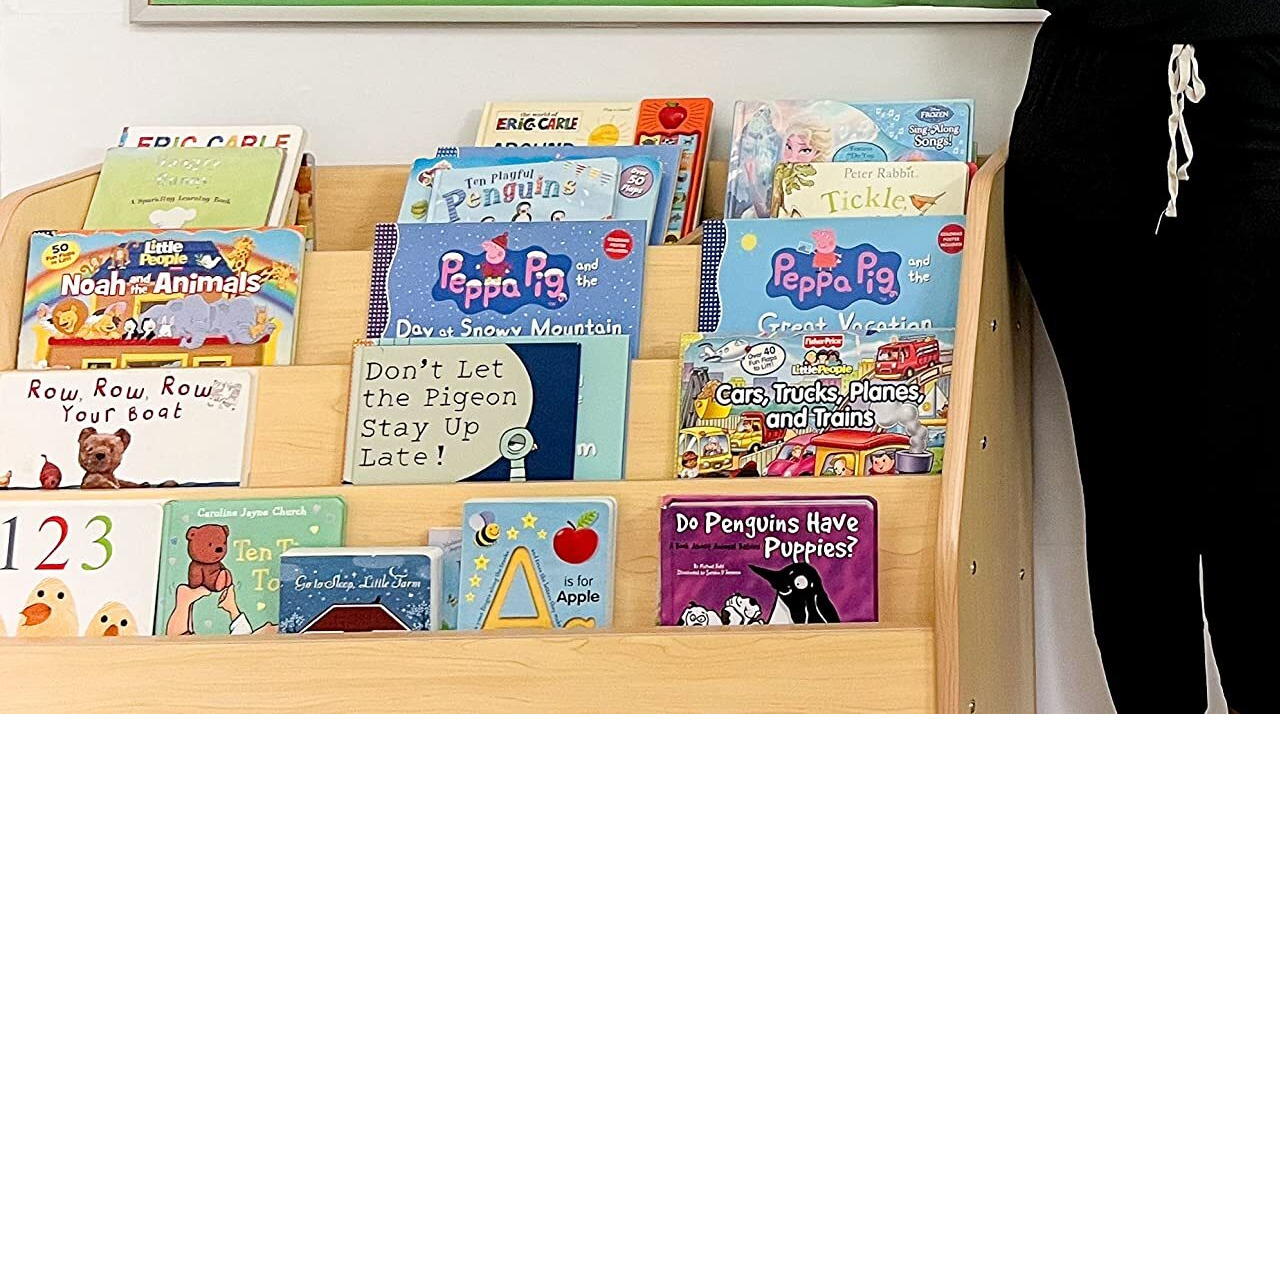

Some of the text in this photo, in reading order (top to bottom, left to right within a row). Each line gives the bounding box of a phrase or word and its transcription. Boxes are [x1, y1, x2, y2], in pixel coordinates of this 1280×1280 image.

[496, 117, 579, 131] ERIC CARLE
[920, 111, 949, 119] FROZEN
[914, 134, 953, 150] Songs!
[464, 168, 535, 190] Ten Playful
[627, 175, 646, 186] 50
[844, 166, 914, 179] Peter Rabbit
[442, 175, 577, 223] Penguins
[820, 187, 908, 215] Tickle,
[52, 243, 69, 254] 50
[145, 239, 184, 254] Little
[139, 252, 188, 267] People
[576, 258, 599, 271] and
[908, 254, 931, 268] and
[61, 273, 262, 297] Noah and Animals
[441, 250, 569, 309] Peppa Pig
[576, 273, 598, 287] the
[774, 251, 898, 302] Peppa Pig
[908, 270, 930, 283] the
[130, 283, 148, 295] the
[396, 318, 622, 337] Day at Snowy Mountain
[804, 337, 842, 346] Fisher-Price
[748, 346, 776, 360] Over 40
[748, 358, 760, 366] Fun
[365, 358, 504, 381] Don't Let
[161, 375, 213, 398] Row
[716, 381, 926, 406] Cars, Trucks, Planes,
[363, 386, 517, 412] the Pigeon
[62, 401, 183, 424] Your Boat
[766, 407, 875, 428] and Trains
[360, 417, 480, 442] Stay Up
[358, 445, 445, 467] Late!
[197, 506, 307, 518] Caroline Jayne Church
[676, 511, 859, 539] Do Penguins Have
[35, 515, 69, 570] 2
[81, 515, 113, 571] 3
[233, 539, 273, 563] Ten
[764, 535, 859, 564] Puppies?
[295, 574, 313, 591] Go
[313, 579, 325, 589] to
[325, 574, 356, 592] Sleep,
[358, 574, 388, 589] Little
[481, 545, 555, 629] A
[564, 575, 594, 587] is for
[556, 590, 600, 606] Apple
